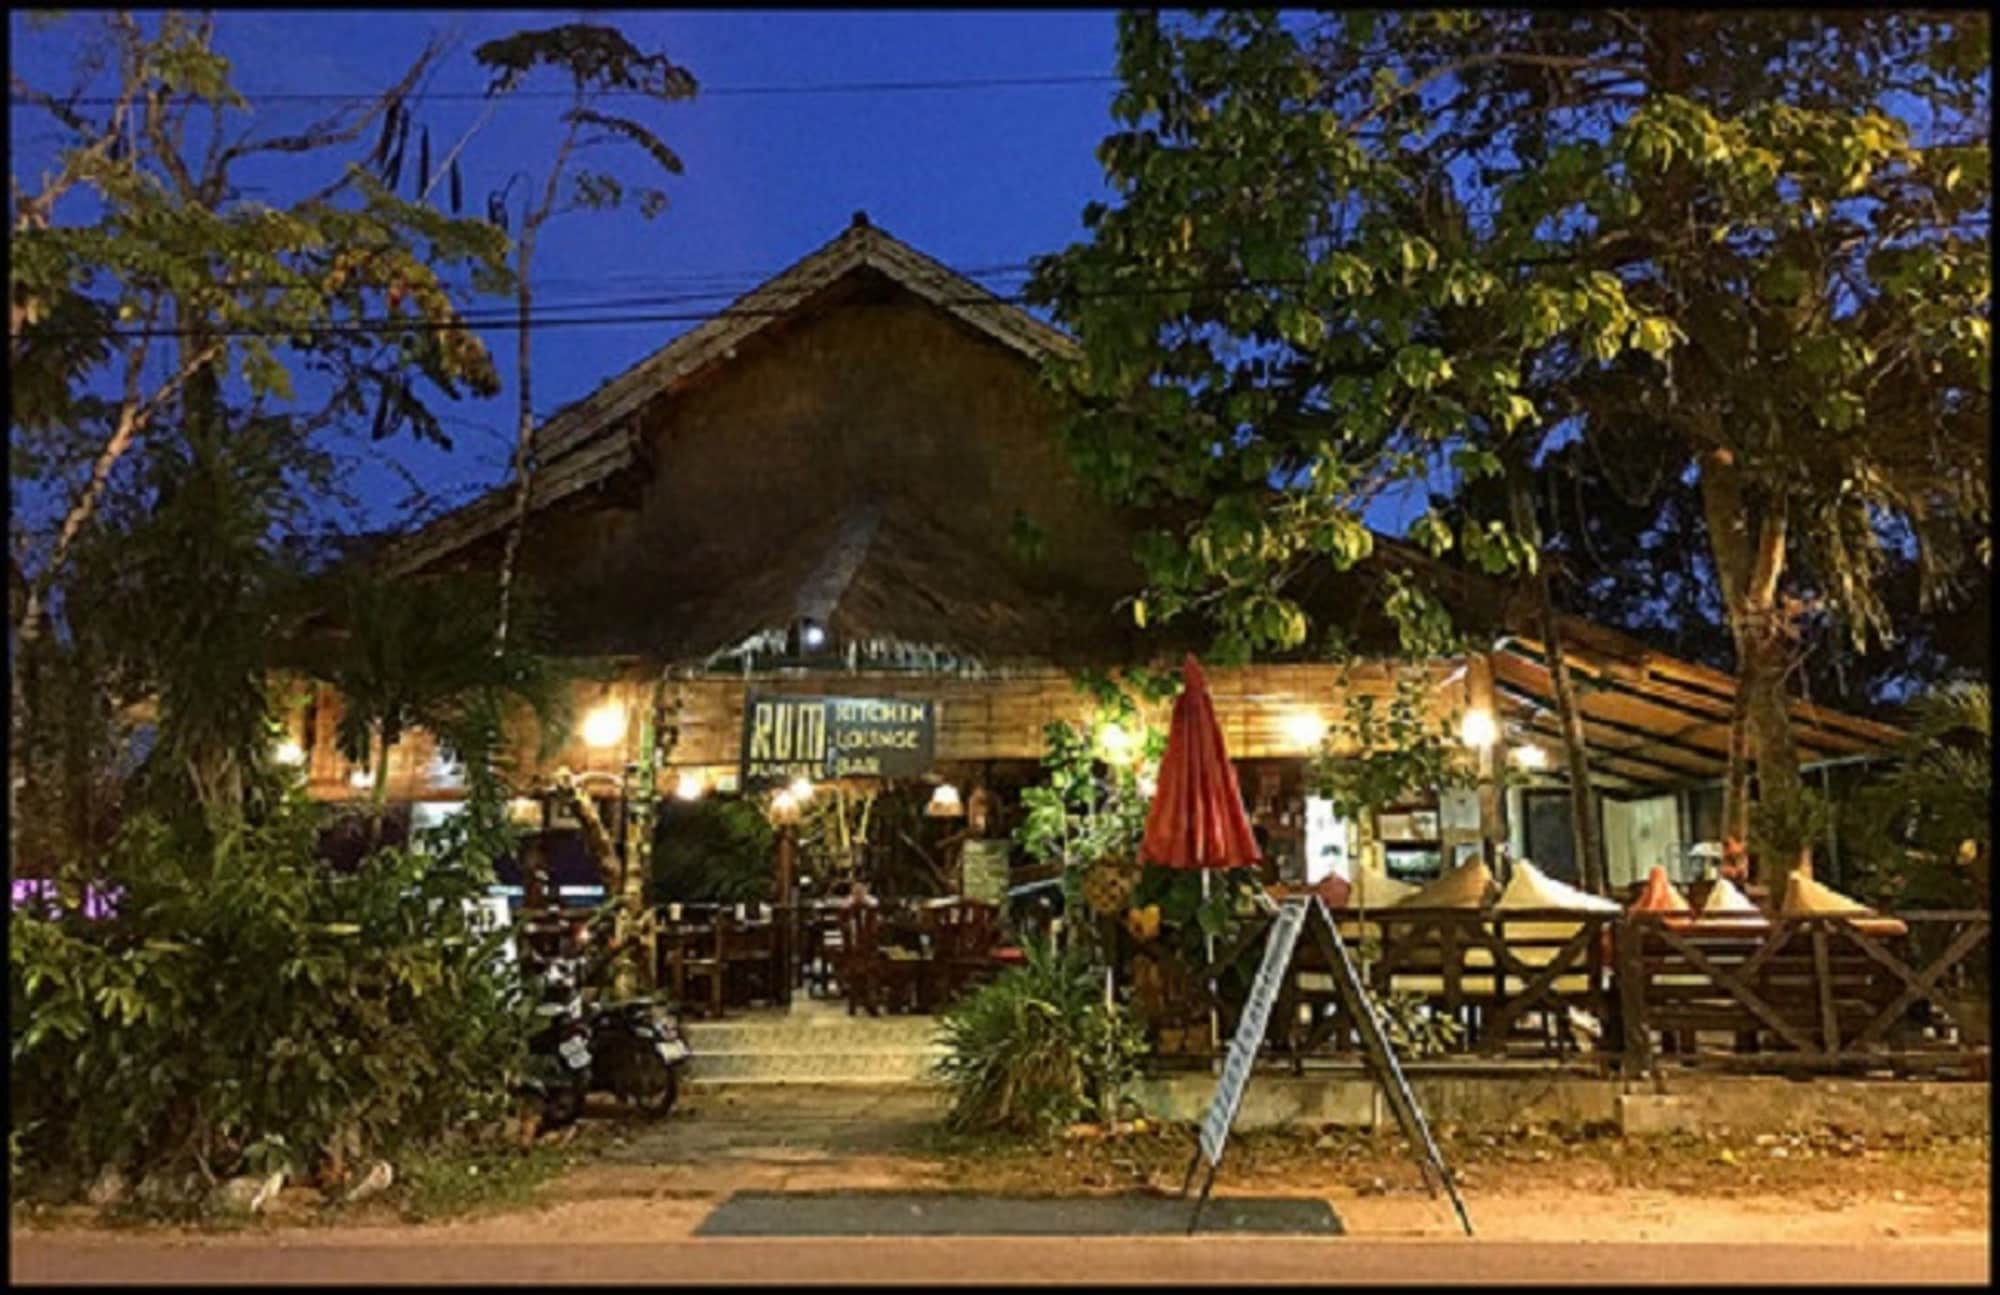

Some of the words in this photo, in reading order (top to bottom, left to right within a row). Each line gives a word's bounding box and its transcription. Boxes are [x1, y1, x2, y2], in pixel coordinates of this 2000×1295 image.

[835, 703, 925, 722] KITCHEN
[750, 703, 826, 760] RUM
[835, 730, 919, 748] LOUNGE
[836, 757, 880, 776] BAR
